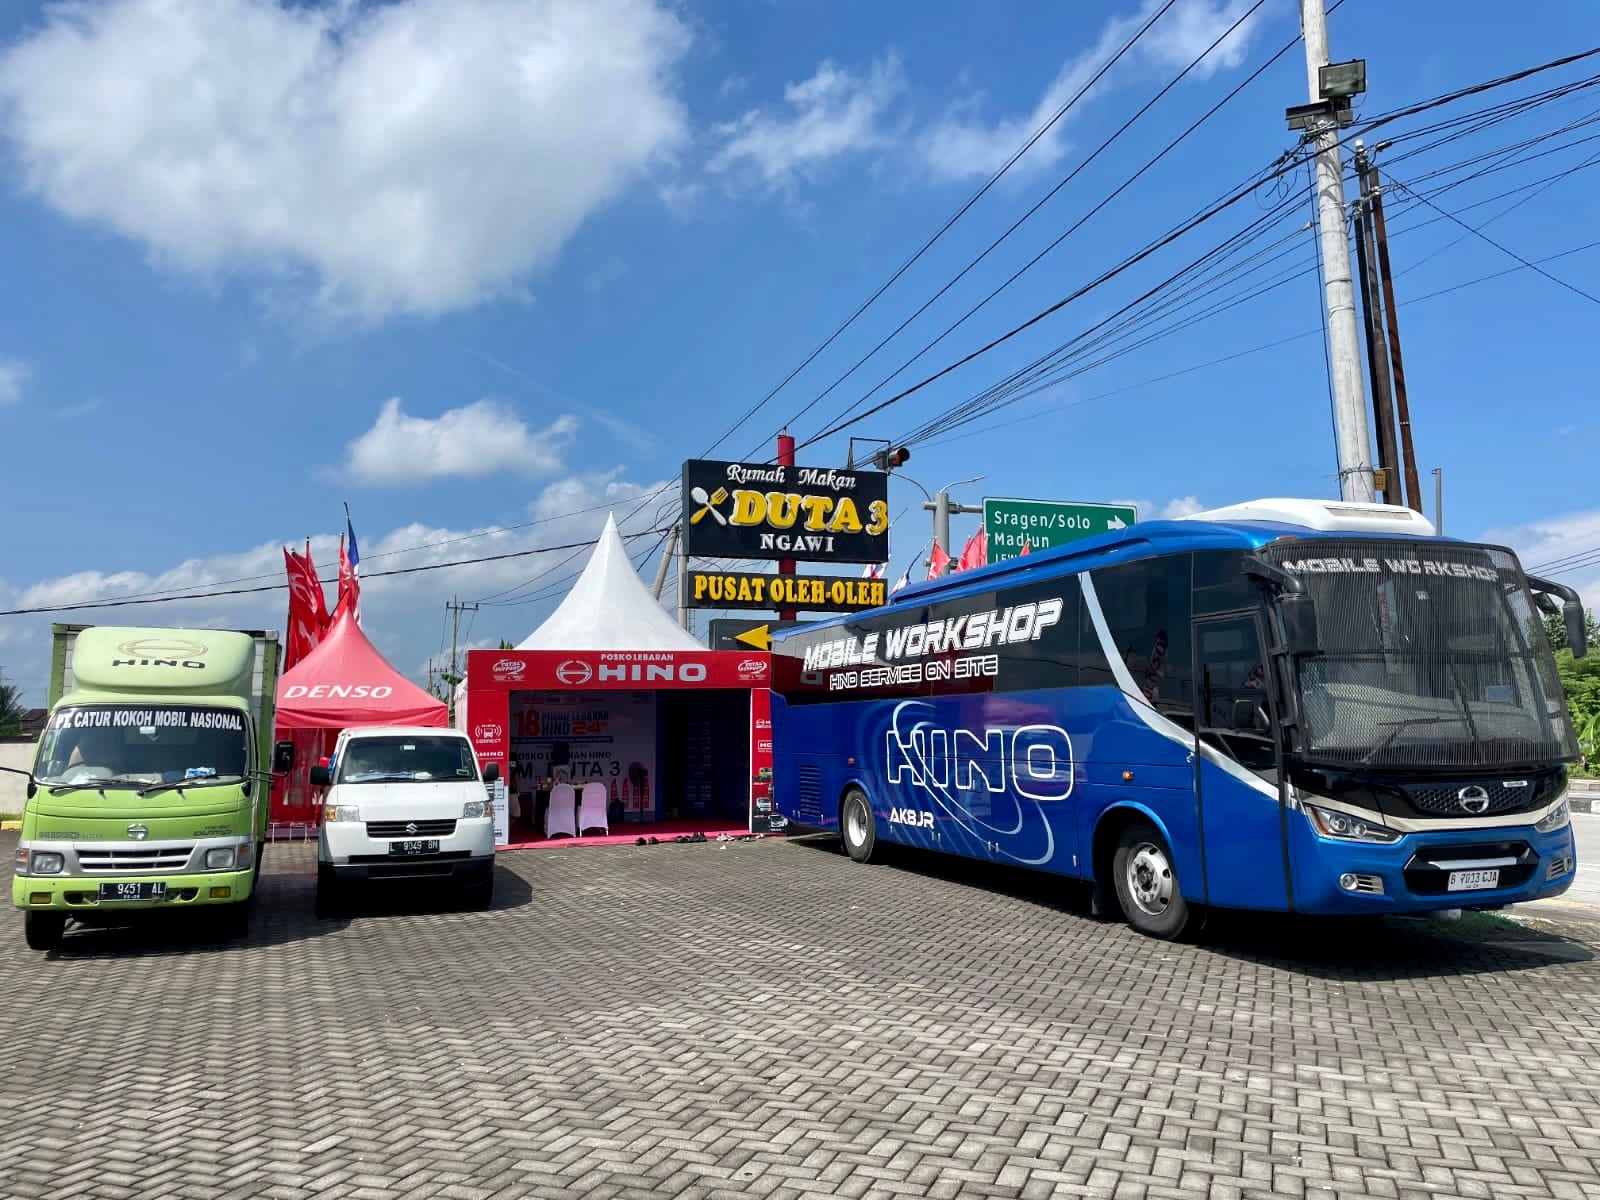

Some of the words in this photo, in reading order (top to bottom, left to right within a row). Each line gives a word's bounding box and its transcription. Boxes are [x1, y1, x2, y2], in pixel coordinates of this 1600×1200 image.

[726, 464, 785, 484] Rumah
[798, 469, 857, 492] Makan
[729, 489, 864, 534] DUTA
[865, 500, 888, 536] 3
[994, 510, 1091, 530] Sragen/Solo
[760, 533, 835, 553] NGAWI
[1282, 557, 1381, 575] MOBILE
[1384, 558, 1499, 583] WORKSHOP
[694, 575, 765, 602] PUSAT
[770, 578, 885, 606] OLEH-OLEH
[802, 630, 879, 673] MOBILE
[884, 597, 1064, 661] WORKSHOP
[112, 658, 206, 670] HINO
[600, 653, 632, 661] POSKO
[633, 653, 674, 662] LEBARAN
[598, 663, 707, 682] HINO
[829, 673, 858, 691] HINO
[860, 663, 922, 687] SERVICE
[925, 660, 951, 681] ON
[954, 654, 999, 679] SITE
[283, 684, 393, 700] DENSO
[74, 711, 111, 728] CATUR
[112, 710, 151, 727] KOKOH
[154, 710, 188, 727] MOBIL
[190, 713, 243, 731] NASIONAL
[609, 761, 621, 777] 3
[886, 724, 1075, 802] HINO
[403, 840, 422, 851] 9049
[100, 883, 108, 895] L
[117, 882, 142, 895] 9451
[151, 881, 164, 894] AL
